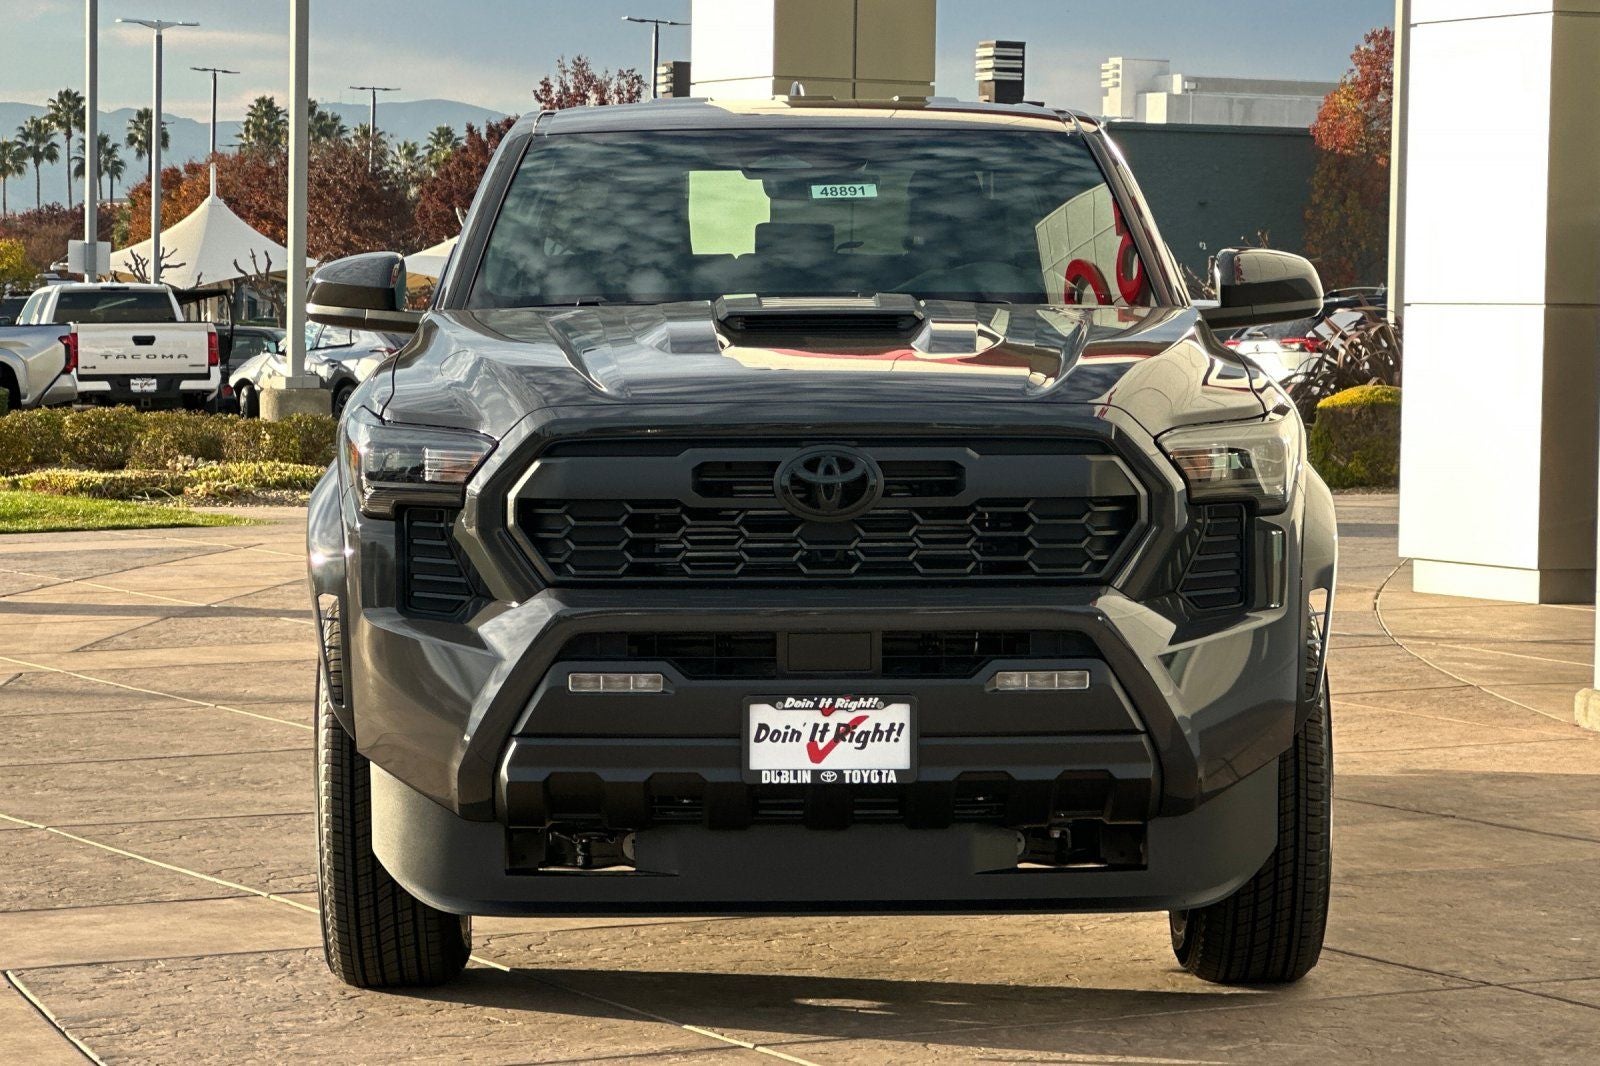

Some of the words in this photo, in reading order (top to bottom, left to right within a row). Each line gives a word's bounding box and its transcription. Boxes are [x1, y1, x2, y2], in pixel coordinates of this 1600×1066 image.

[820, 186, 866, 197] 48891
[784, 697, 818, 709] Doin'
[819, 697, 832, 709] It
[834, 697, 879, 712] Right!
[753, 722, 807, 744] Doin'
[808, 722, 830, 743] It
[833, 722, 905, 751] Right!
[761, 769, 811, 784] DUBLIN
[843, 769, 897, 784] TOYOTA
